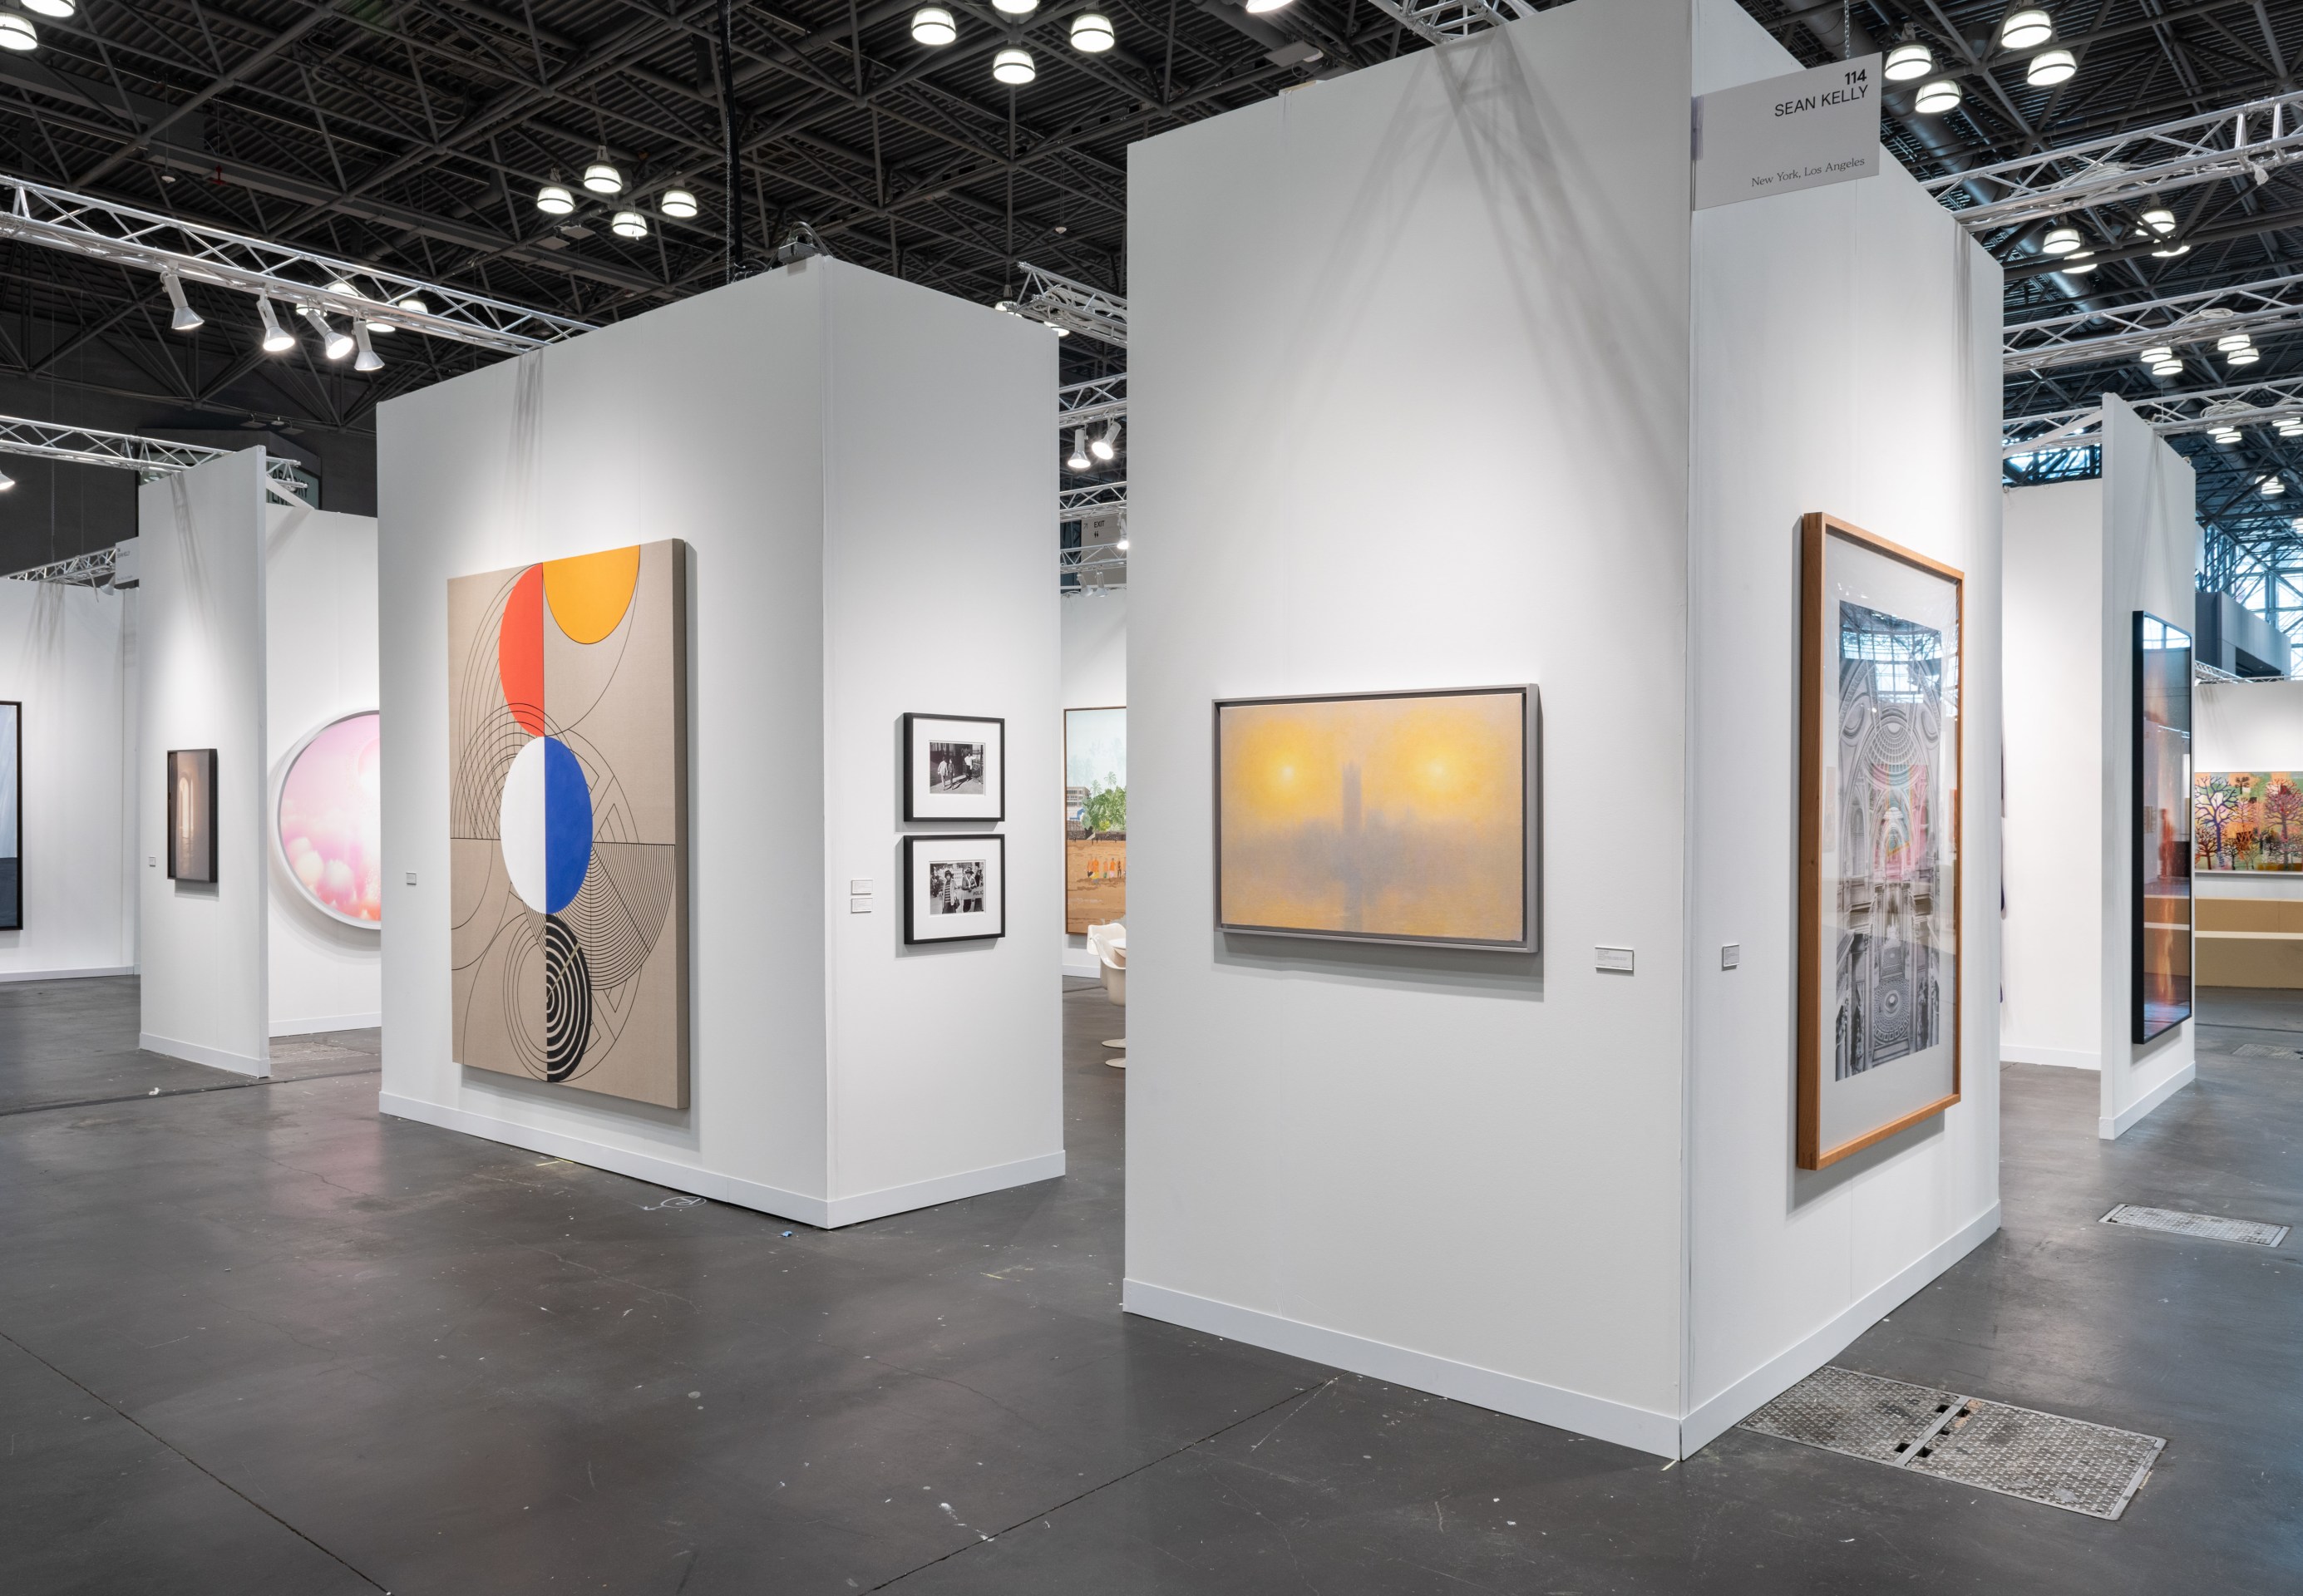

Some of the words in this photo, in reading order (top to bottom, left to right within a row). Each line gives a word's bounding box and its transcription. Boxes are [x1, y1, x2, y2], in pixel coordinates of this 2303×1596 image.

[1844, 69, 1867, 86] 114
[1774, 96, 1816, 117] SEAN
[1821, 85, 1868, 107] KELLY
[1751, 176, 1773, 187] New
[1776, 170, 1802, 182] York,
[1804, 166, 1822, 177] Los
[1825, 158, 1865, 174] Angeles
[273, 468, 309, 499] ARORY
[1093, 520, 1105, 529] EXIT
